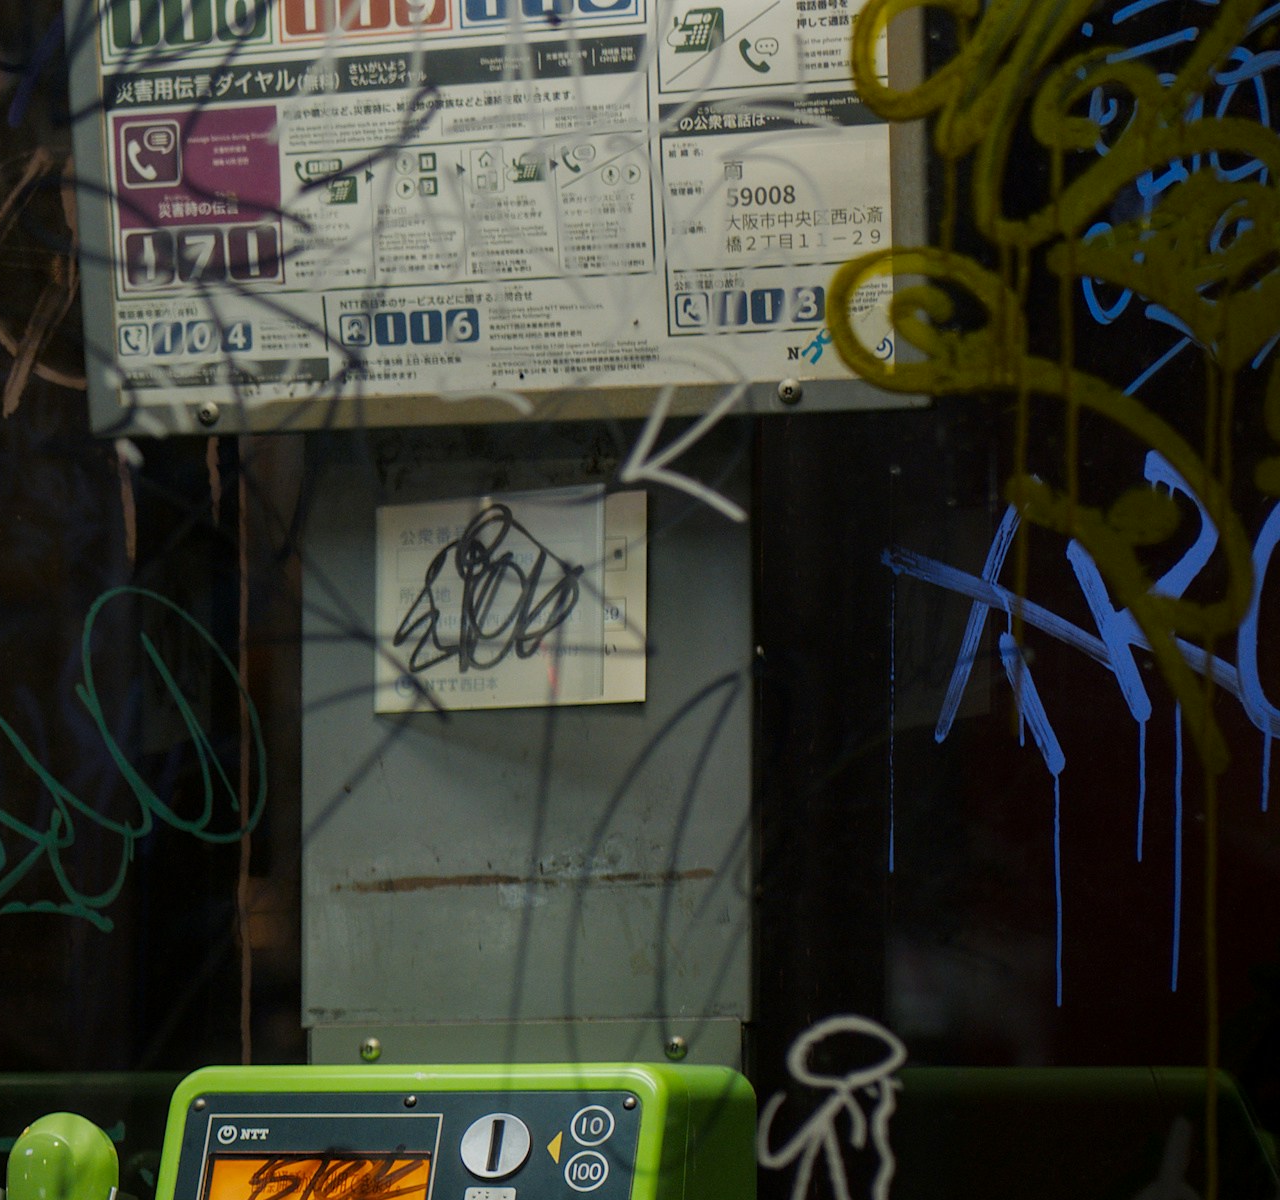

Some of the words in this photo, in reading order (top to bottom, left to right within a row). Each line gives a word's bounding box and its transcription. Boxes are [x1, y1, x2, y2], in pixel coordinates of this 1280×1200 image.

[130, 0, 256, 44] 110
[847, 96, 859, 104] This
[669, 111, 780, 132] の公衆電話は…
[727, 185, 796, 208] 59008
[727, 205, 883, 232] 大阪市中央区西心斎
[143, 228, 261, 280] 171
[340, 290, 533, 309] NTT西日本のサービスなどに関する問合せ
[725, 290, 818, 323] 113
[164, 322, 247, 352] 104
[386, 311, 473, 342] 116
[400, 585, 451, 605] 所地
[240, 1127, 270, 1142] NTT
[580, 1115, 605, 1137] 10
[572, 1161, 602, 1183] 100
